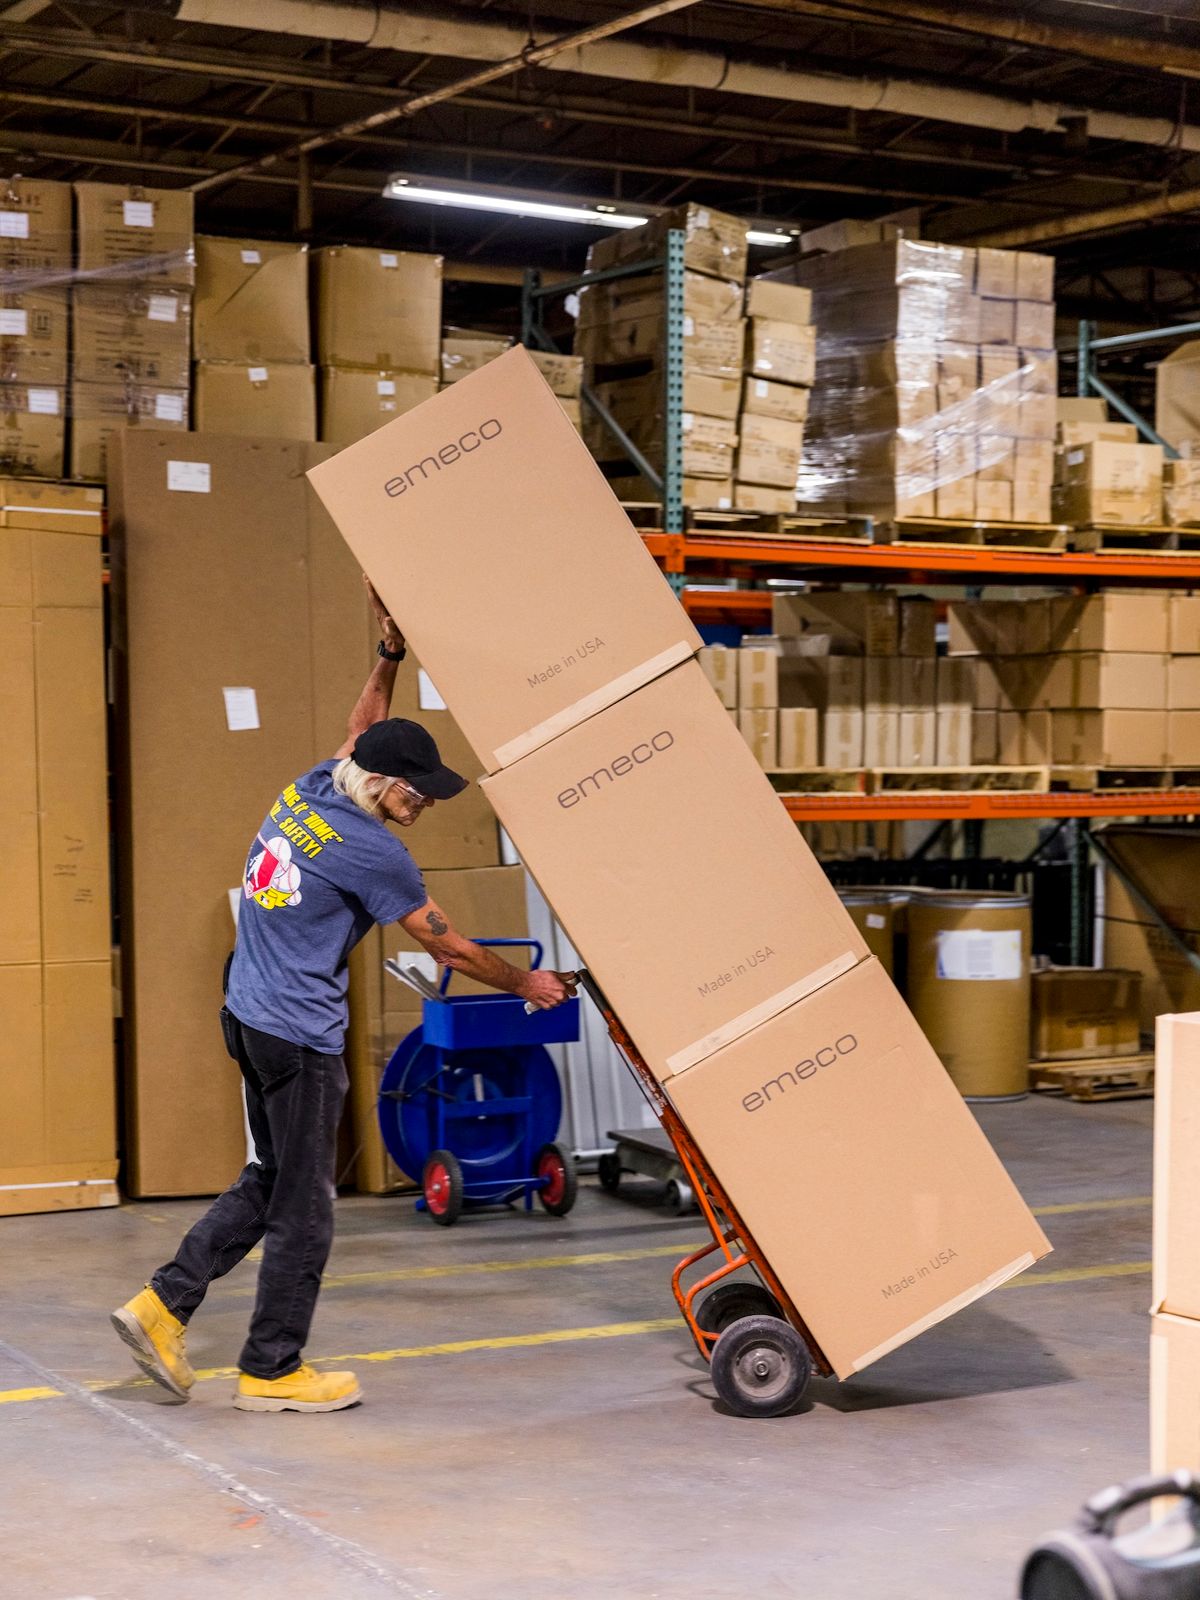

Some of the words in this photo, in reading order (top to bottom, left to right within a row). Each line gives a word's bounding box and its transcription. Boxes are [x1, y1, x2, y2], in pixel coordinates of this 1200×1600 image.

[384, 418, 503, 498] emeco
[527, 664, 562, 689] Made
[561, 655, 577, 668] in
[576, 637, 606, 658] USA
[557, 729, 675, 809] emeco
[278, 816, 324, 859] SAFETY!
[697, 972, 733, 998] Made
[731, 964, 747, 977] in
[745, 946, 776, 967] USA
[741, 1033, 858, 1113] emeco
[881, 1275, 916, 1300] Made
[915, 1266, 930, 1279] in
[929, 1248, 959, 1270] USA
